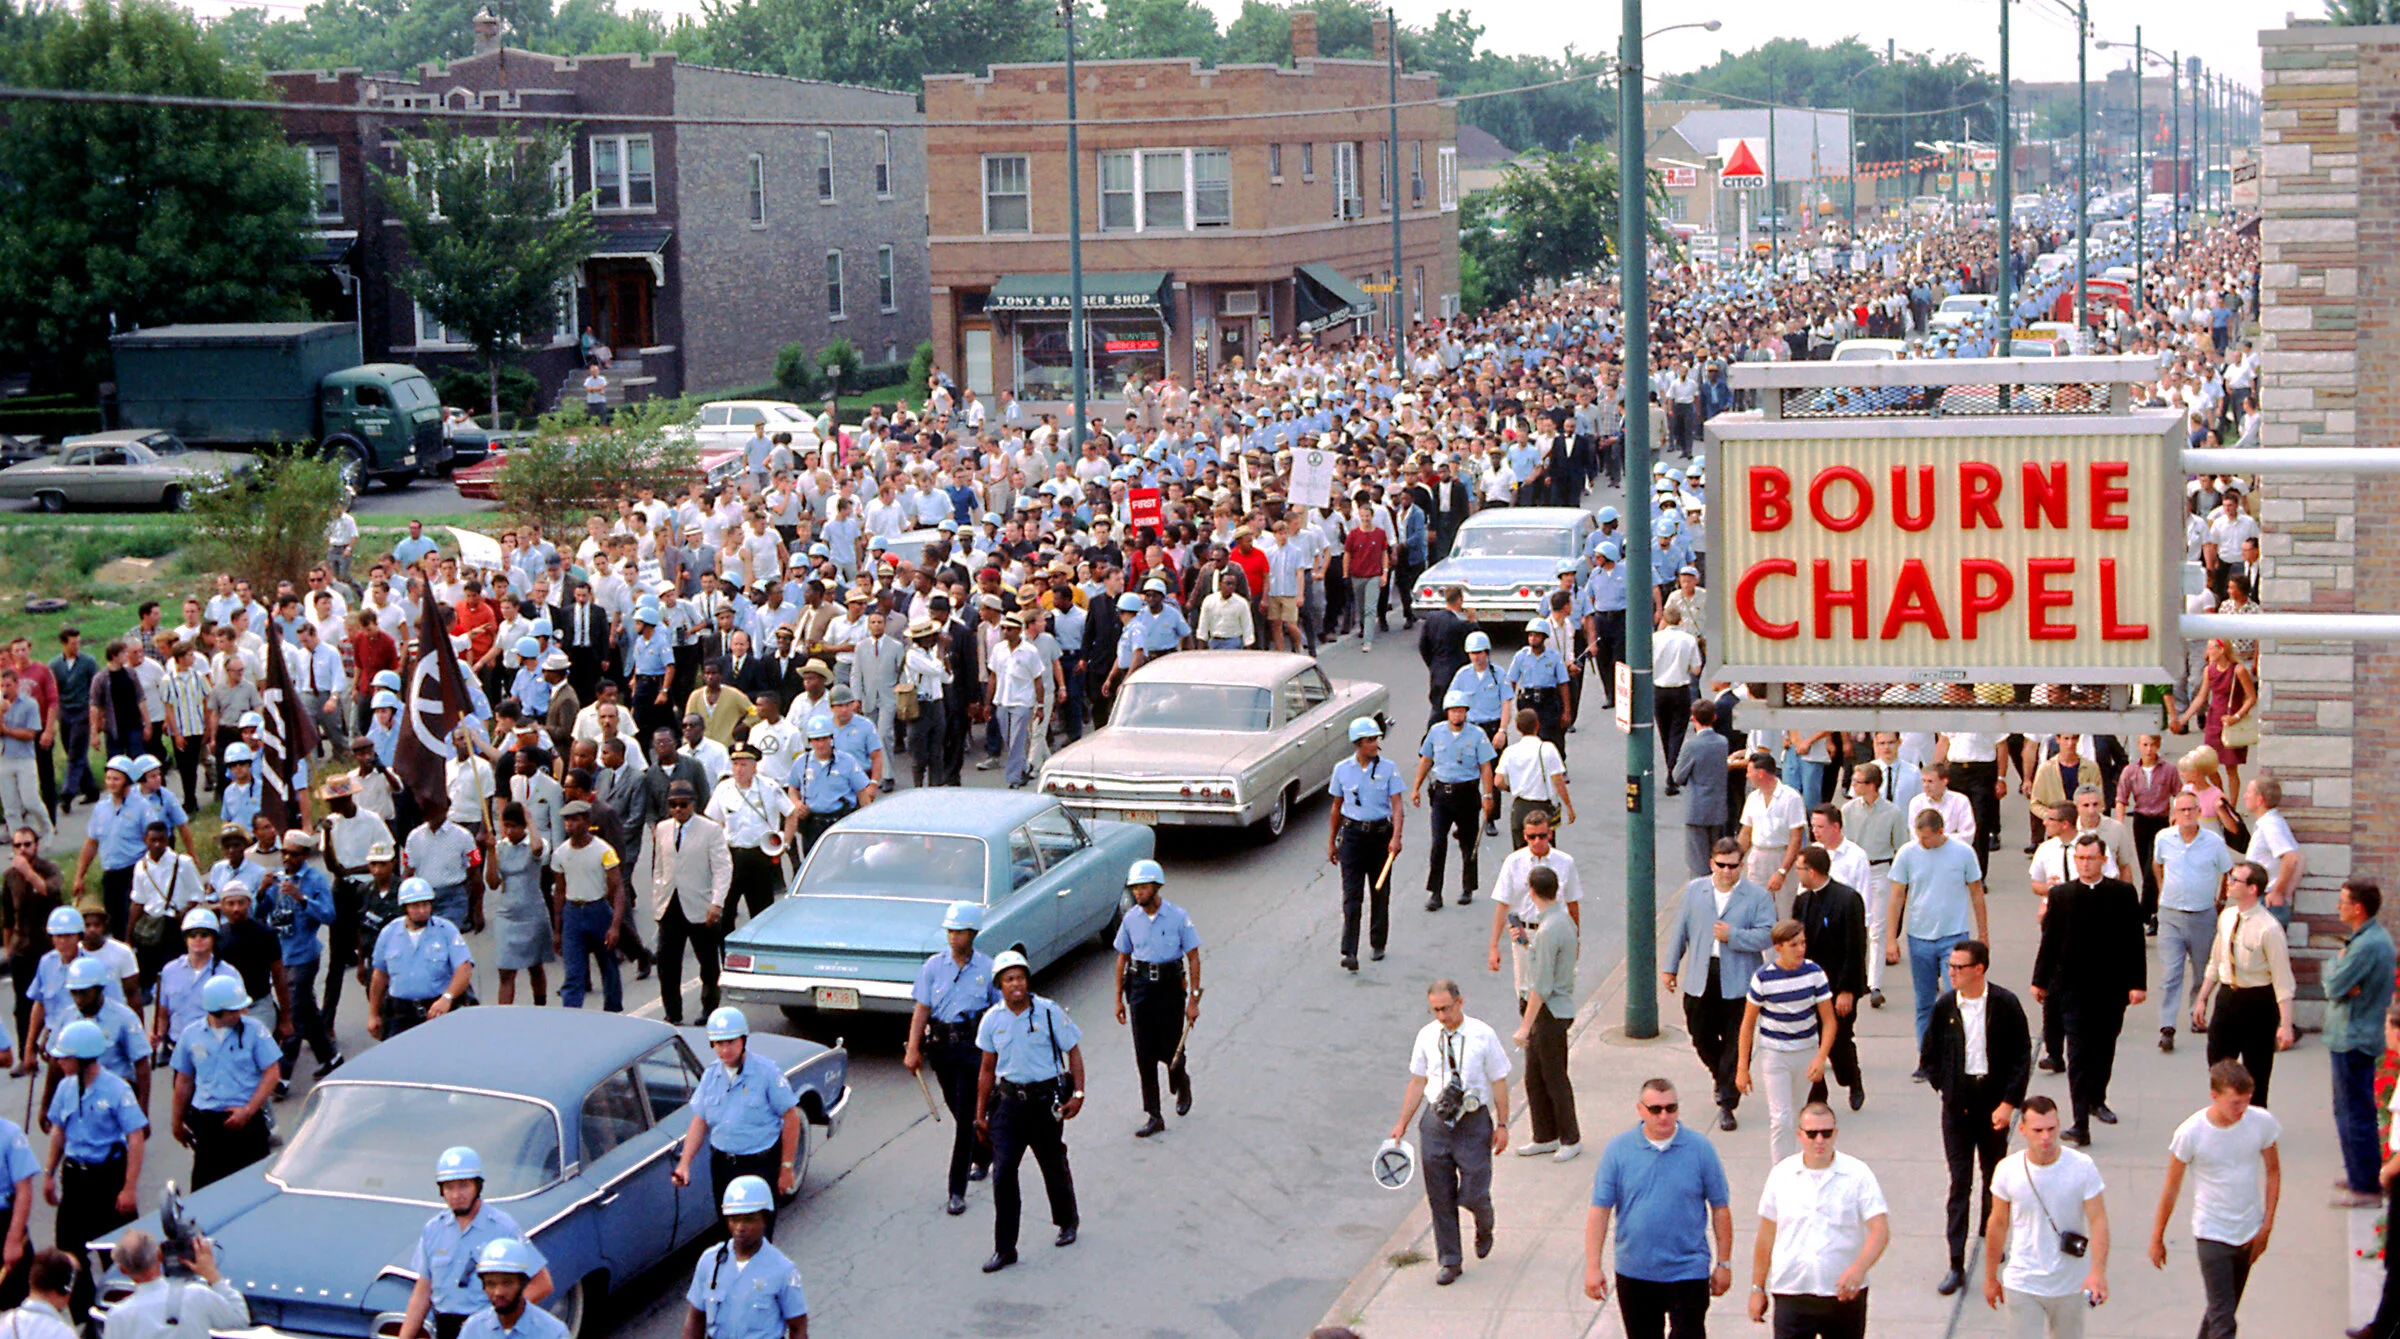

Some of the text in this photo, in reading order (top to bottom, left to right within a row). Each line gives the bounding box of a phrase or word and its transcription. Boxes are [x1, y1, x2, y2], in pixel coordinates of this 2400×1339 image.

[1723, 177, 1763, 188] CITGO
[1051, 296, 1106, 306] BABER
[1114, 294, 1150, 305] SHOP
[1749, 462, 2129, 532] BOURNE
[1132, 499, 1156, 509] FIRST
[1736, 558, 2149, 640] CHAPEL
